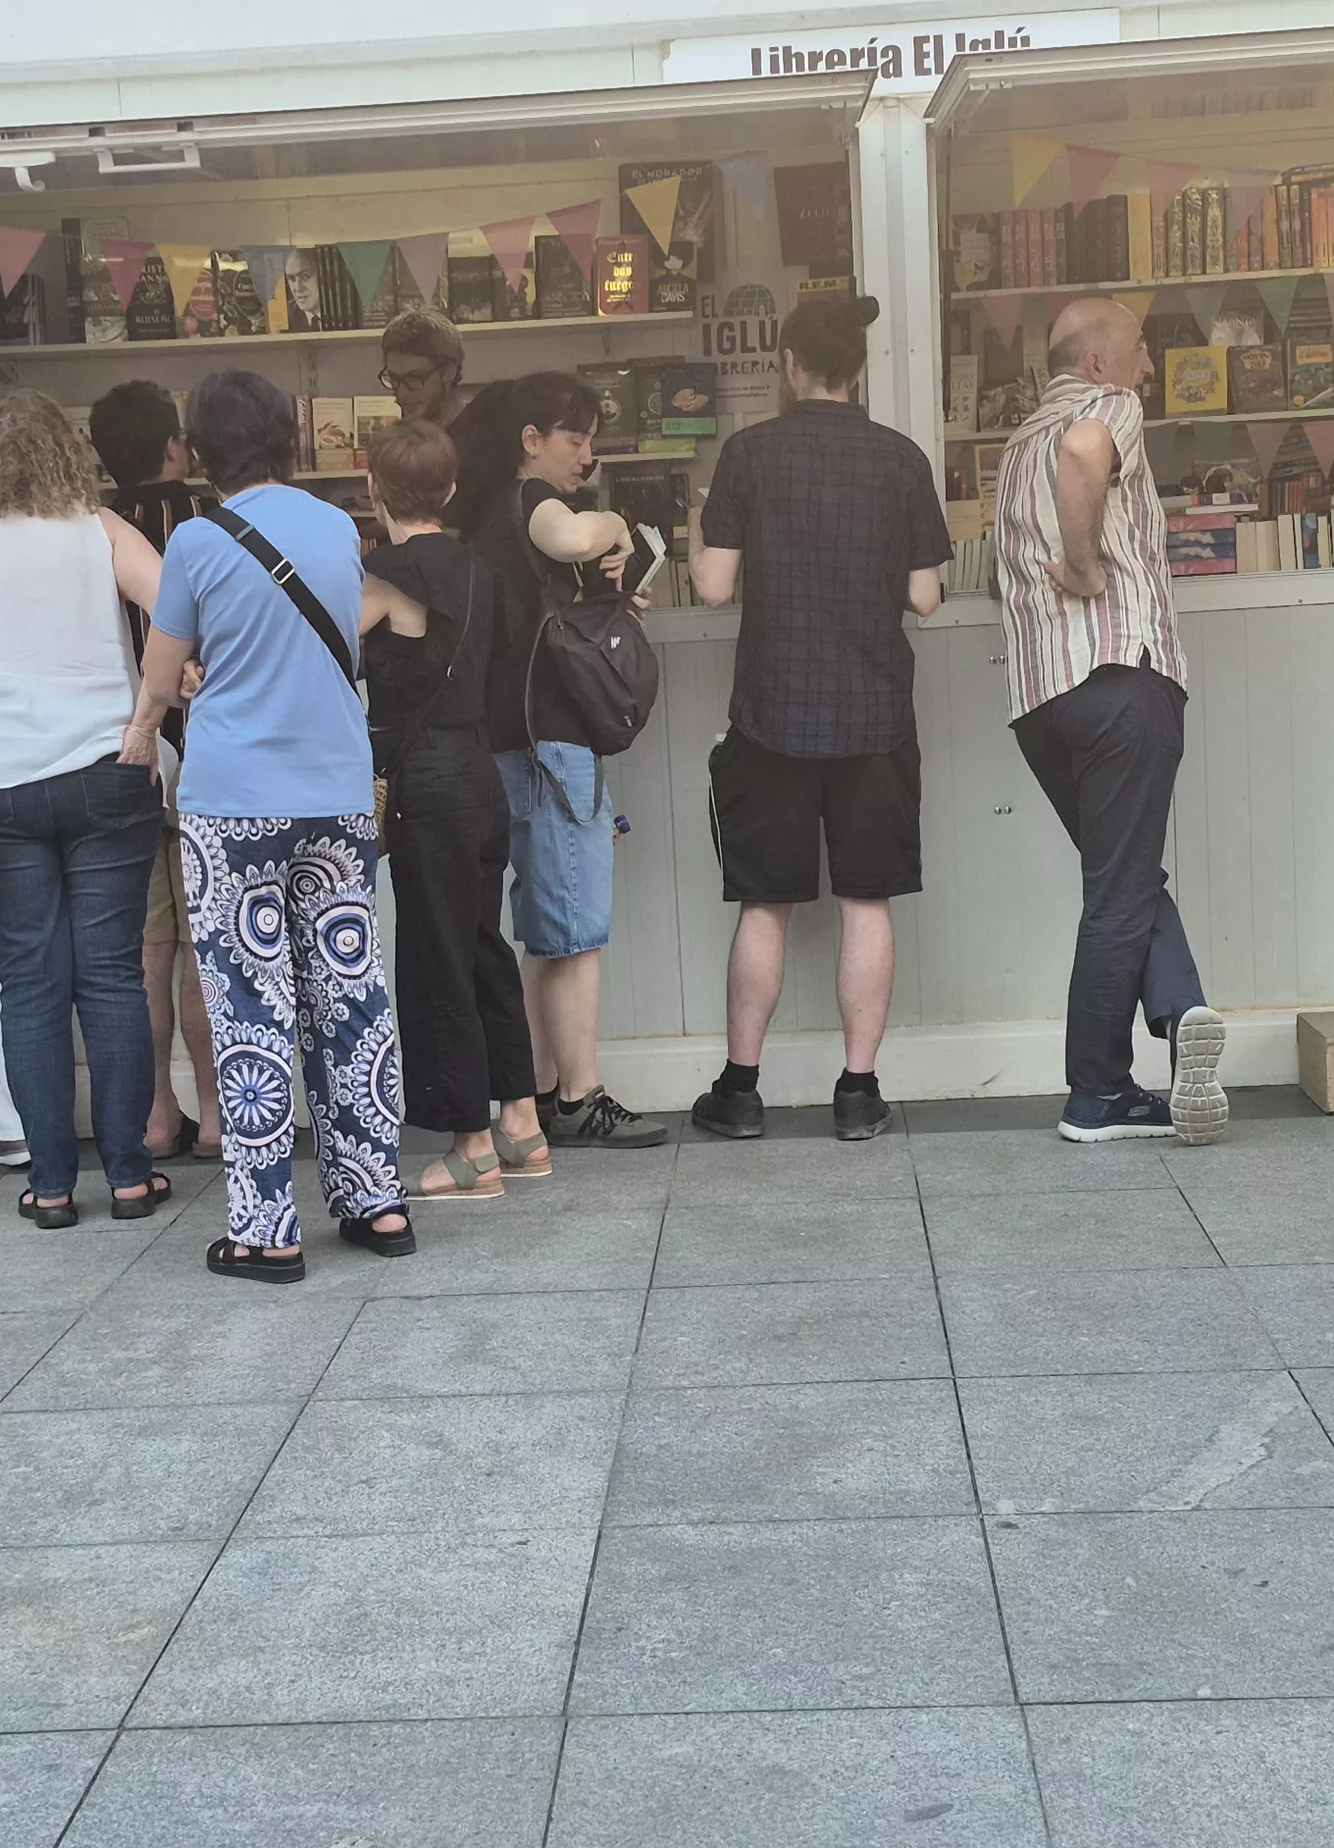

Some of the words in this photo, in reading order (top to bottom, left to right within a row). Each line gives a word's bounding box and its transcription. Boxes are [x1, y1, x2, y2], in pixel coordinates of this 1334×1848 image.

[751, 37, 903, 78] Librería
[913, 34, 944, 76] El
[607, 251, 633, 263] Entr
[701, 294, 719, 319] EL
[701, 315, 779, 357] IGLÚ
[716, 357, 780, 376] BRERÍA
